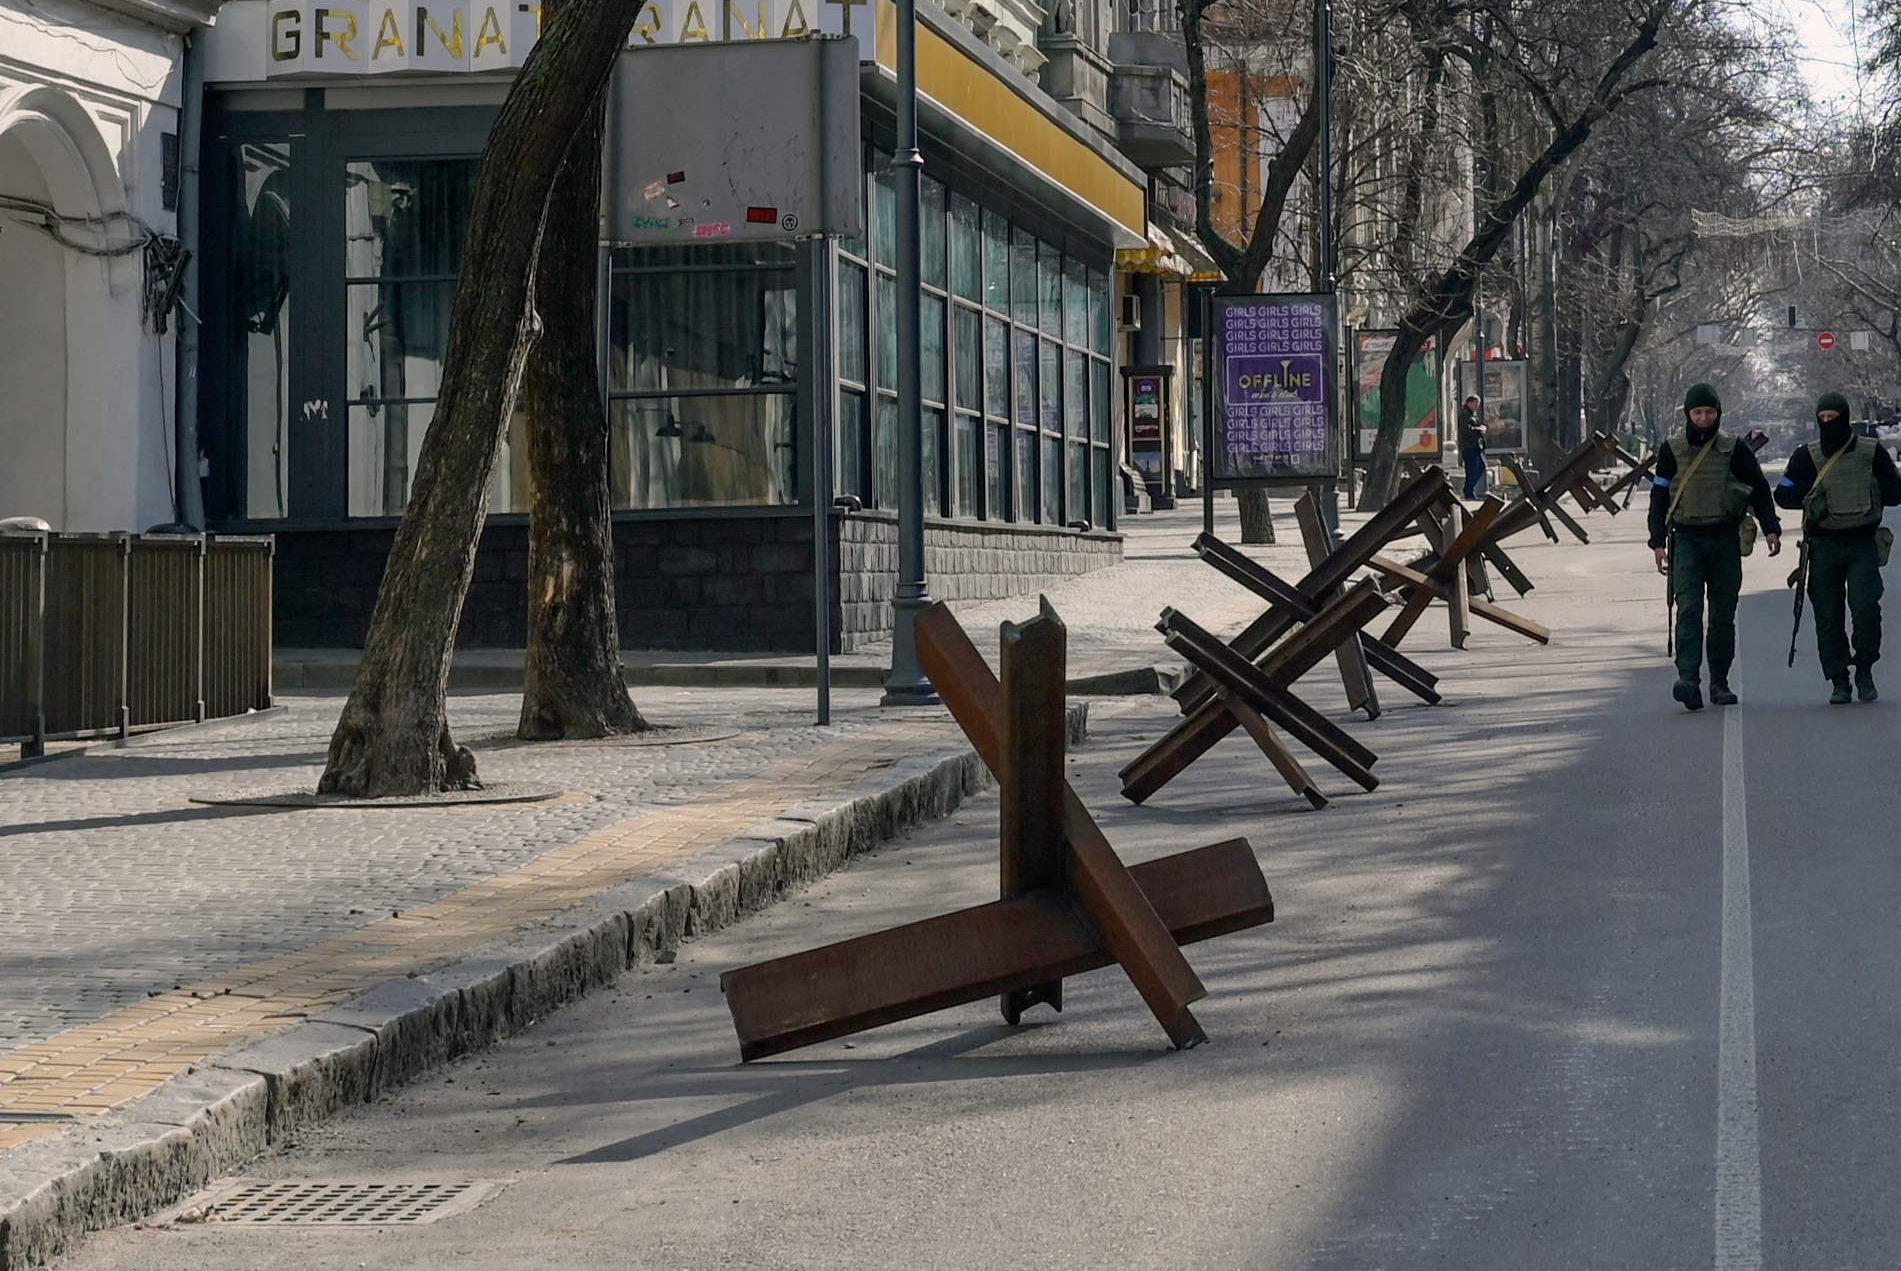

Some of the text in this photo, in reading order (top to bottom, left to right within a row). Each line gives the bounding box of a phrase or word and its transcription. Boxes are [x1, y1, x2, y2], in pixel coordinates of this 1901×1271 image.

[1226, 305, 1321, 317] GIRLS GIRLS GIRLS
[1226, 317, 1321, 329] GIRLS GIRLS GIRLS
[1226, 329, 1322, 341] GIRLS GIRLS GIRLS
[1226, 341, 1322, 353] GIRLS GIRLS GIRLS
[1239, 361, 1311, 389] OFFLINE
[1227, 405, 1323, 417] GIRLS GIRLS GIRLS
[1227, 417, 1324, 430] GIRLS GIRLS GIRLS
[1227, 429, 1324, 441] GIRLS GIRLS GIRLS
[1227, 441, 1324, 453] GIRLS GIRLS GIRLS
